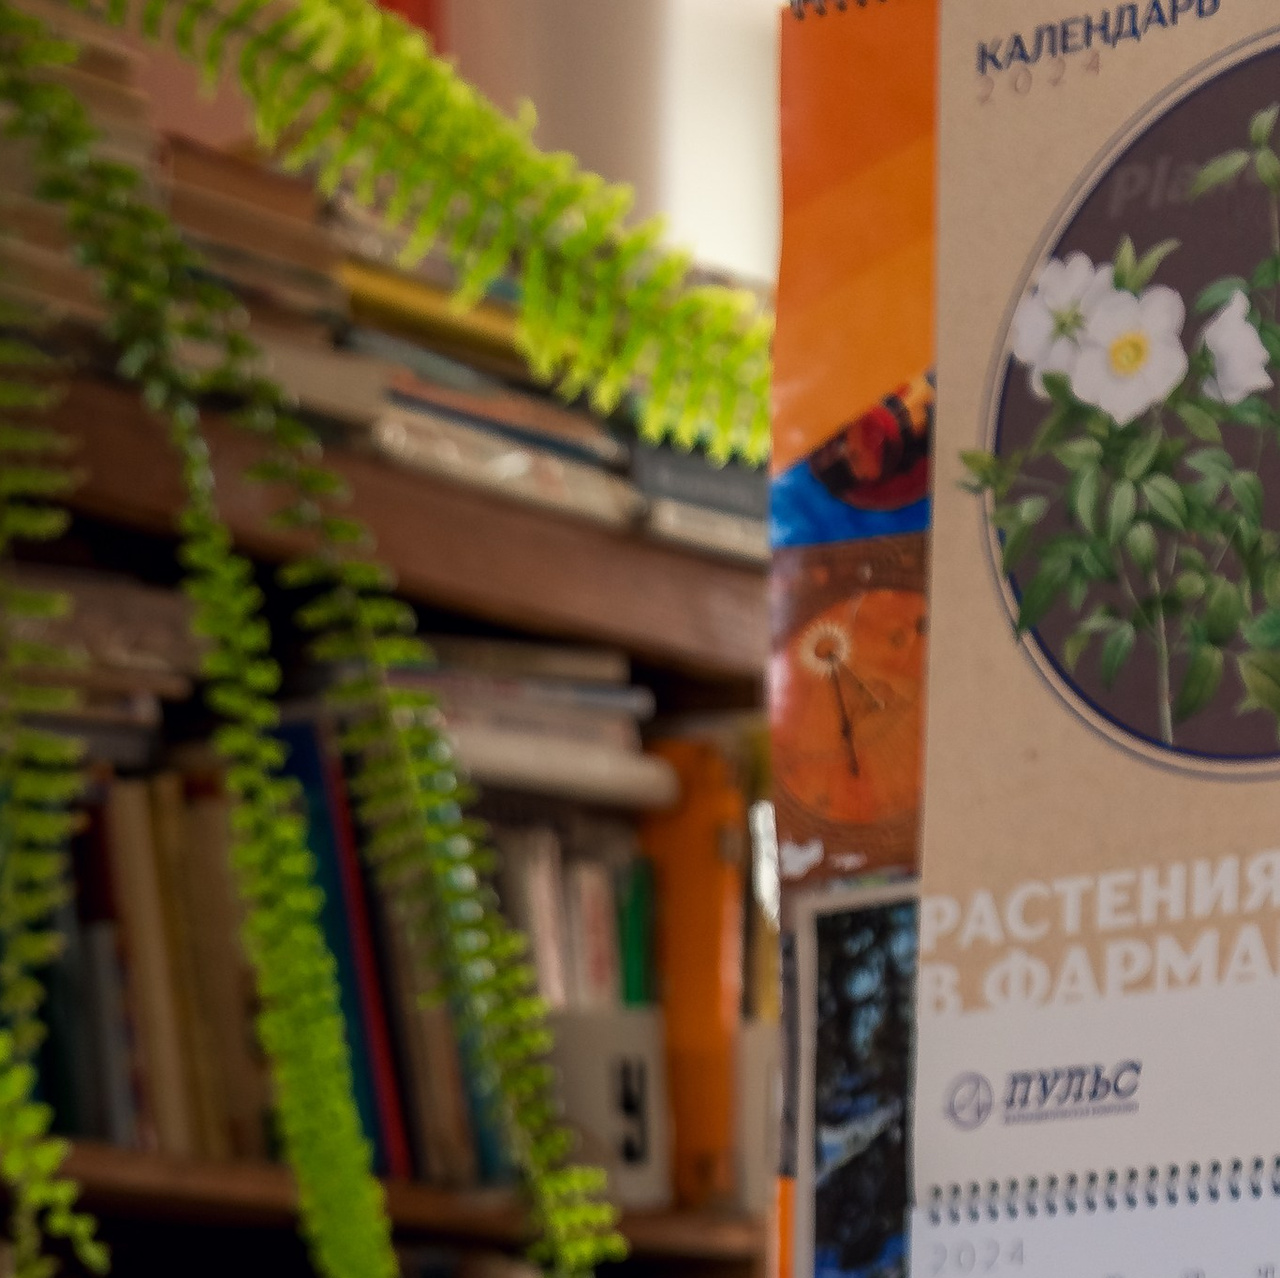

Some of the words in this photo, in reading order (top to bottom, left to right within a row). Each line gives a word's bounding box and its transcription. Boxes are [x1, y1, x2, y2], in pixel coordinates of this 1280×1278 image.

[920, 848, 1280, 954] РАСТЕНИЯ
[981, 921, 1280, 1009] ФАРМА
[1004, 1057, 1143, 1111] ПУЛЬС
